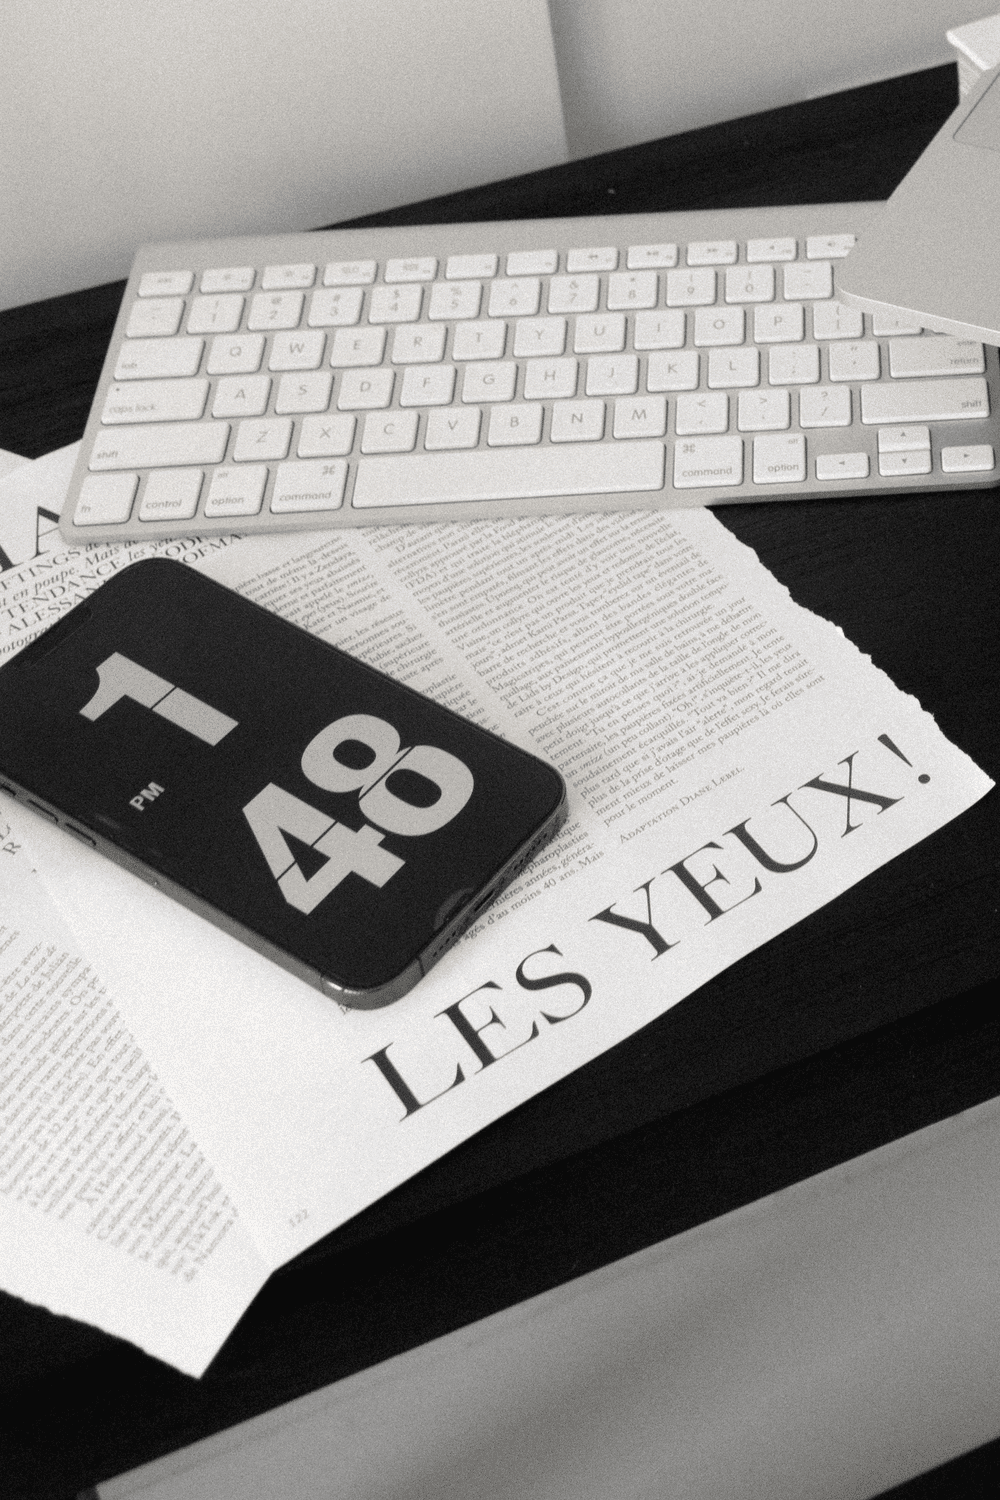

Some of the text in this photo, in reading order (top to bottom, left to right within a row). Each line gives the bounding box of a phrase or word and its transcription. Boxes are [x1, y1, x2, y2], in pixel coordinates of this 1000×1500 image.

[746, 284, 754, 293] 0
[714, 320, 725, 330] O
[774, 316, 782, 326] P
[536, 330, 544, 340] Y
[594, 327, 605, 336] U
[414, 337, 423, 347] R
[476, 333, 483, 343] T
[290, 343, 305, 354] W
[354, 340, 361, 350] E
[230, 347, 242, 357] Q
[729, 361, 736, 371] L
[950, 357, 979, 365] return
[608, 368, 614, 378] J
[668, 364, 678, 374] K
[483, 374, 496, 384] G
[545, 371, 556, 381] H
[360, 382, 371, 392] D
[423, 378, 431, 388] F
[235, 390, 246, 400] A
[300, 386, 308, 395] S
[572, 413, 583, 423] N
[632, 410, 647, 419] M
[448, 420, 458, 430] V
[511, 417, 519, 427] B
[320, 428, 332, 439] X
[384, 424, 395, 435] C
[256, 431, 269, 442] Z
[97, 451, 118, 460] shift
[682, 466, 732, 477] command
[768, 463, 799, 472] option
[212, 496, 245, 507] option
[279, 491, 332, 502] command
[146, 500, 182, 510] control
[34, 568, 80, 597] poupe.
[85, 545, 120, 568] Mais
[5, 549, 146, 620] TENDANCE les
[79, 652, 239, 746] 1
[129, 782, 165, 812] PM
[243, 714, 474, 915] 48
[511, 888, 542, 910] moins
[541, 877, 557, 890] 40
[558, 868, 578, 881] ans.
[577, 850, 604, 868] Mais
[360, 944, 594, 1123] LES
